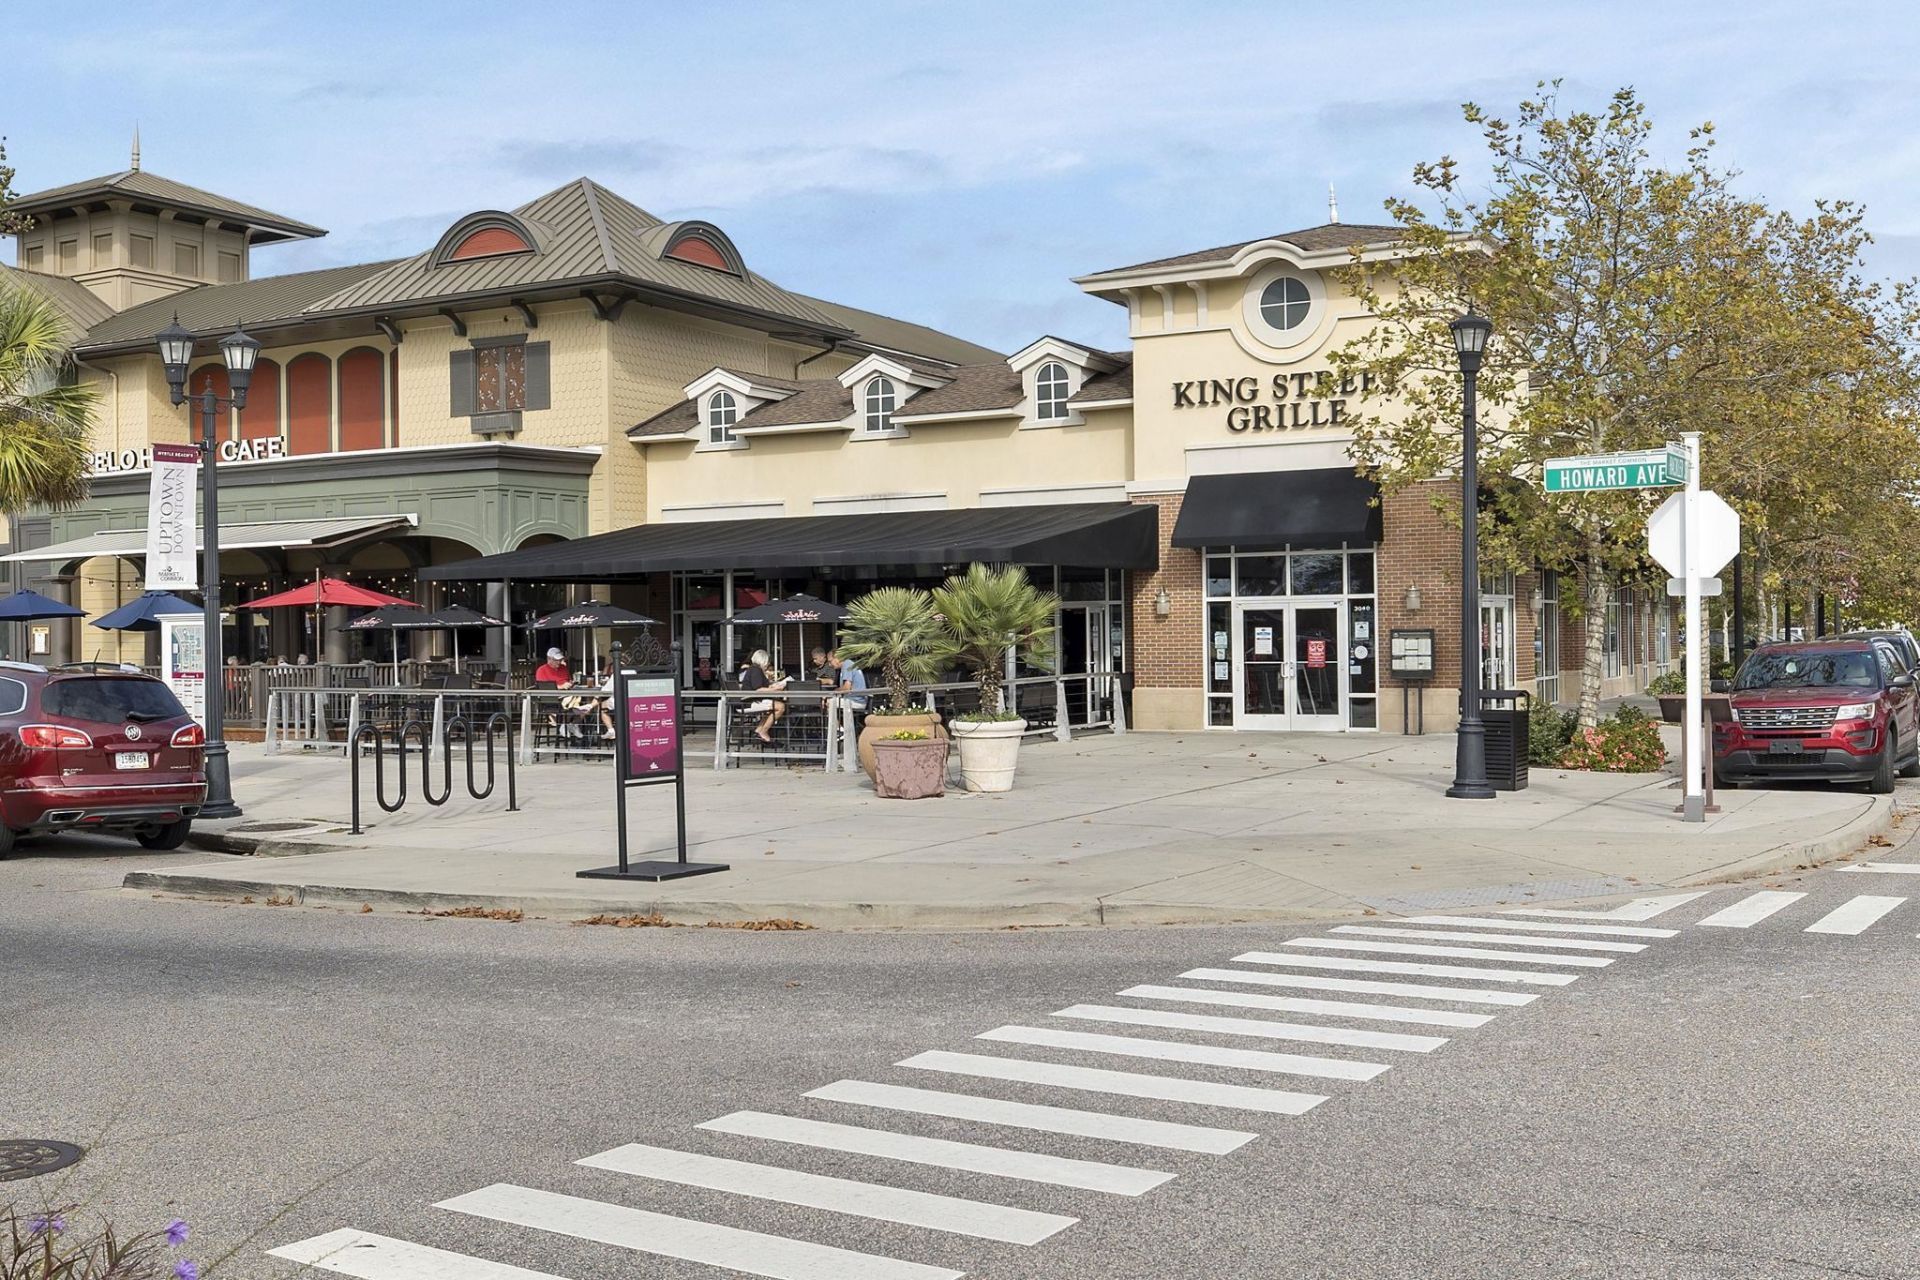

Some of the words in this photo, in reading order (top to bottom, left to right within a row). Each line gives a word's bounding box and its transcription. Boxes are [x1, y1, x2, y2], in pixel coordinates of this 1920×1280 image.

[1173, 377, 1259, 407] KING
[1272, 369, 1378, 399] STREE
[1227, 399, 1347, 432] GRILLE
[221, 435, 286, 461] CAFE
[1560, 467, 1628, 489] HOWARD
[1636, 464, 1667, 484] AVE
[159, 467, 176, 555] UPTOWN
[173, 468, 185, 554] DOWNTOWN
